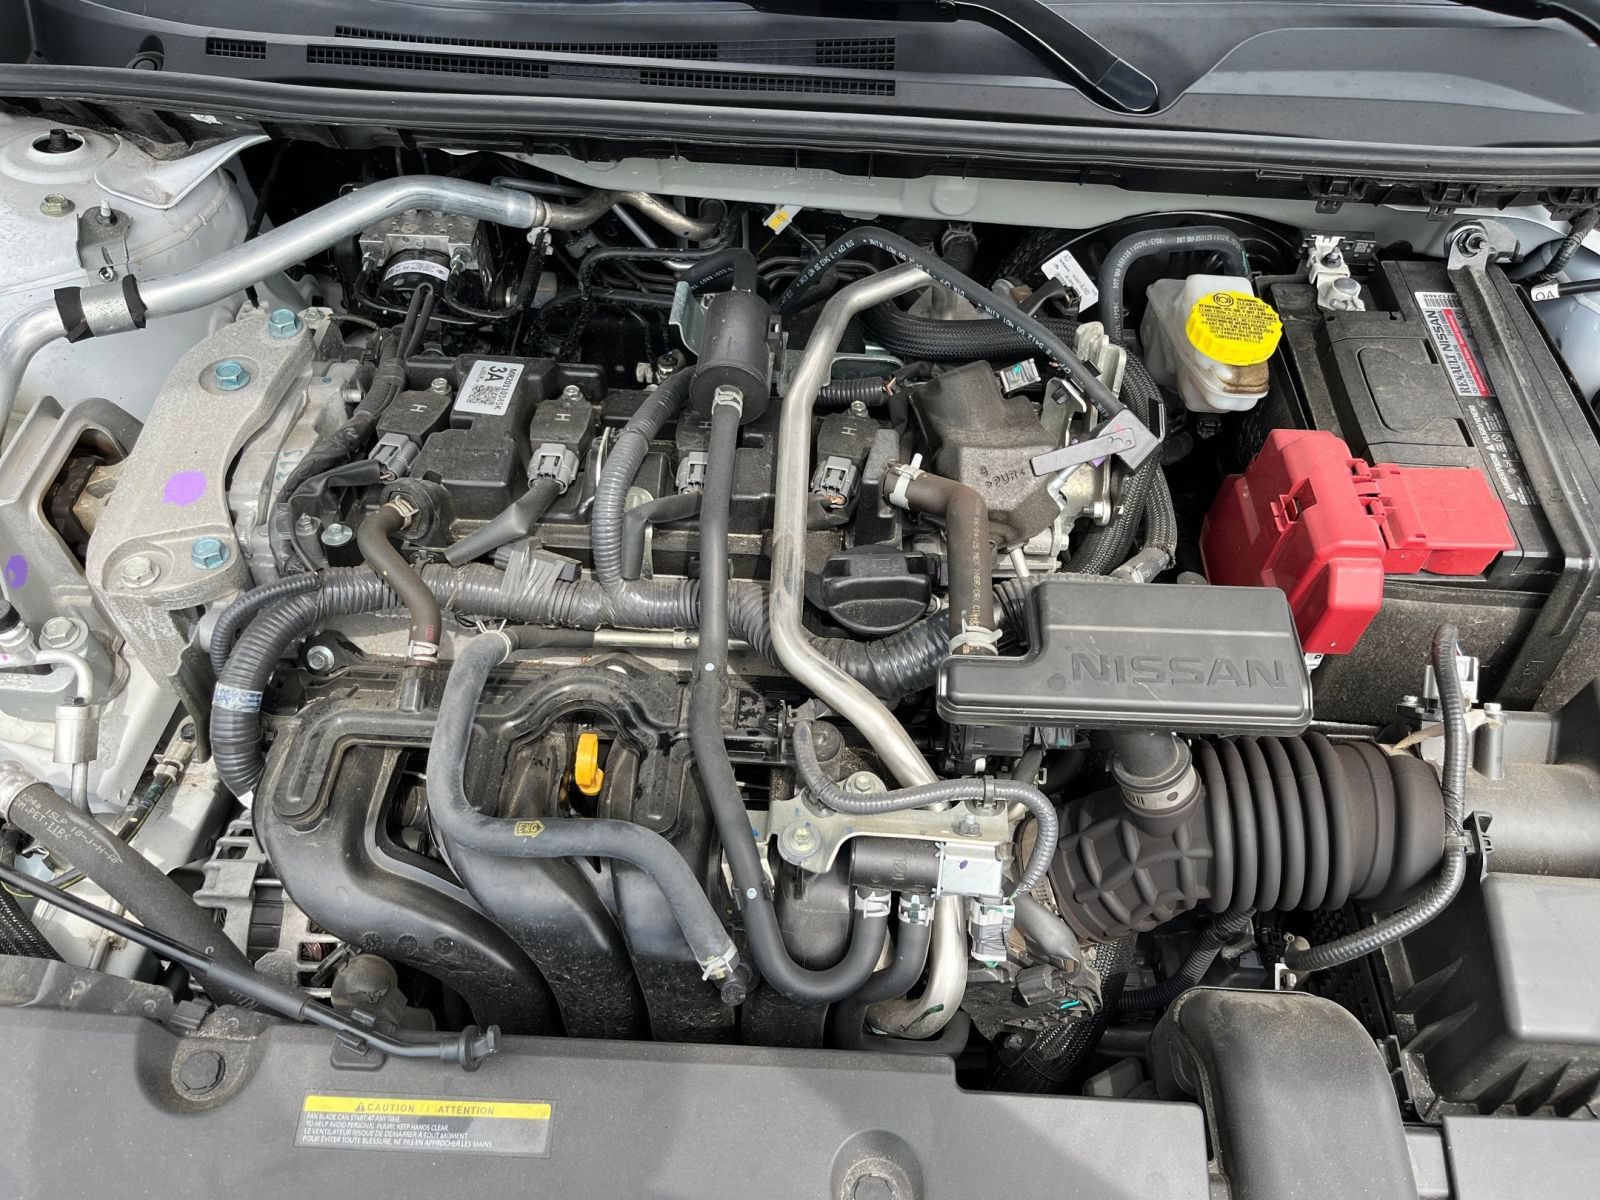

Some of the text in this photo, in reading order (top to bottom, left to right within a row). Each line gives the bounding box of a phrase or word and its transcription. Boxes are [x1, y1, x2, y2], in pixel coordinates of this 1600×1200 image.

[1425, 310, 1453, 352] NISSAN
[484, 365, 508, 382] 3A
[1446, 353, 1472, 394] RENAULT
[1071, 652, 1288, 688] NISSAN
[367, 1103, 415, 1112] CAUTION
[437, 1106, 495, 1115] ATTENTION
[314, 1119, 328, 1127] HELP
[328, 1120, 346, 1128] AVOID
[349, 1113, 367, 1121] START
[374, 1114, 386, 1122] ANY
[311, 1127, 351, 1136] VENTILATEUR
[351, 1128, 374, 1137] RISQUE
[422, 1130, 439, 1138] TOUT
[302, 1134, 320, 1142] POUR
[341, 1136, 360, 1144] TOUTE
[423, 1138, 460, 1147] APPROCHER
